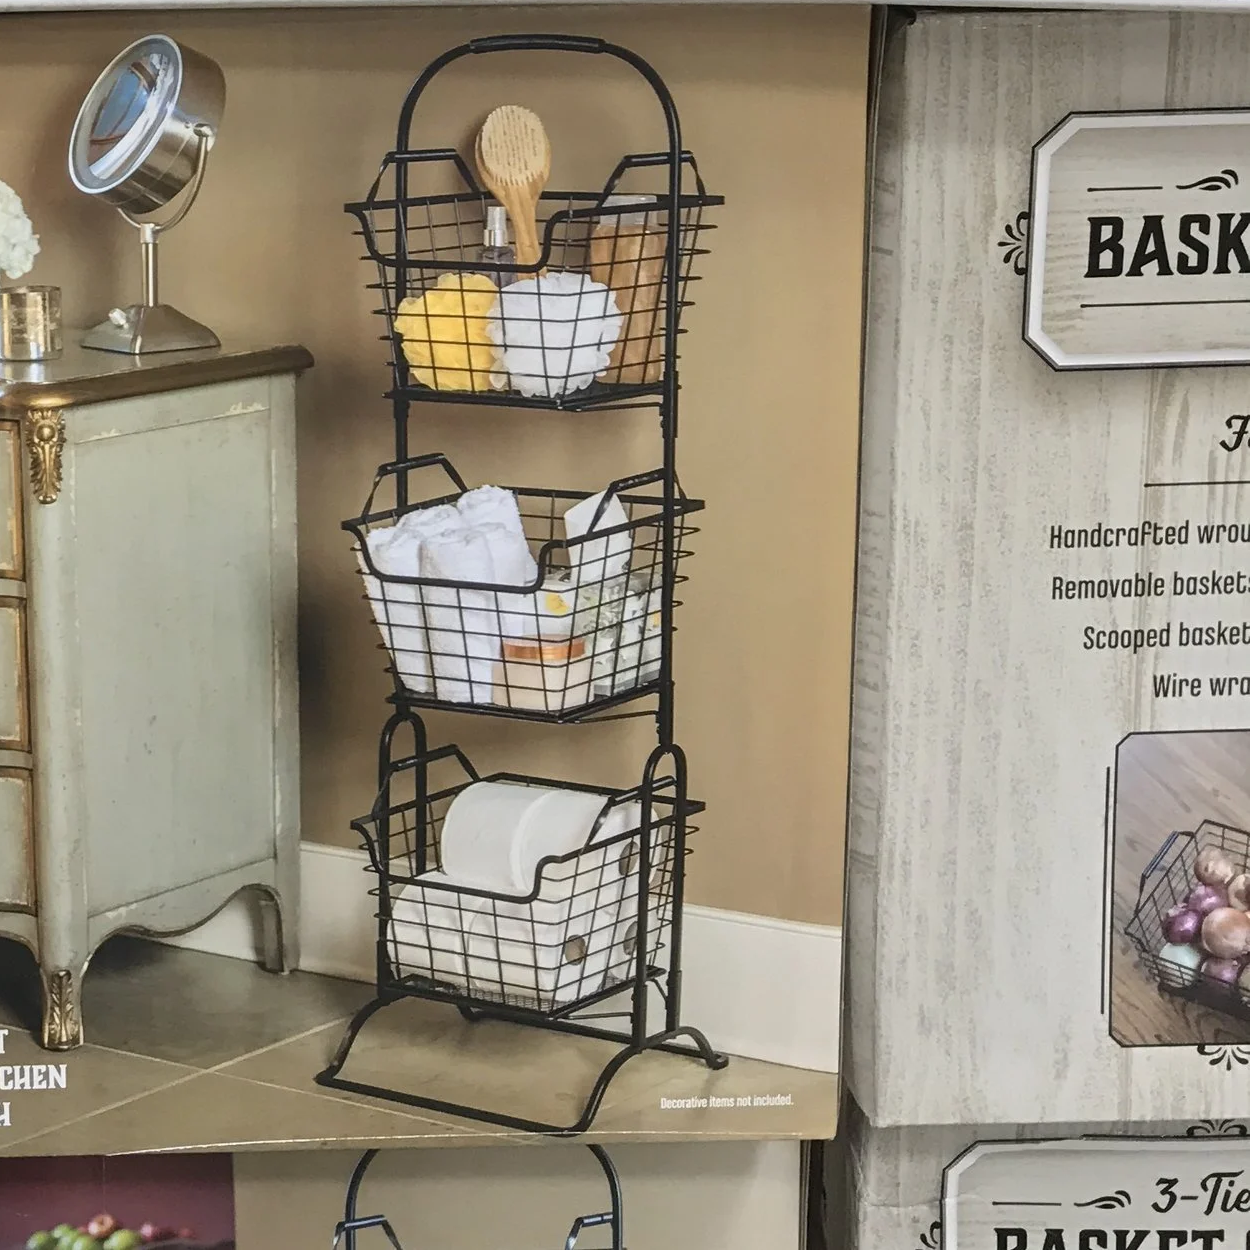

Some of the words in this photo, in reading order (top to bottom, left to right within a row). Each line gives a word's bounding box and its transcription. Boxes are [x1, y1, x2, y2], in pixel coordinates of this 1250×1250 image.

[1083, 212, 1250, 278] BASK
[1050, 520, 1189, 549] Handcrafted
[1051, 572, 1165, 600] Removable
[1083, 622, 1170, 654] Scooped
[1153, 673, 1201, 697] Wire
[660, 1096, 707, 1109] Decorative
[709, 1096, 734, 1108] items
[736, 1095, 751, 1107] not
[753, 1094, 794, 1106] included.
